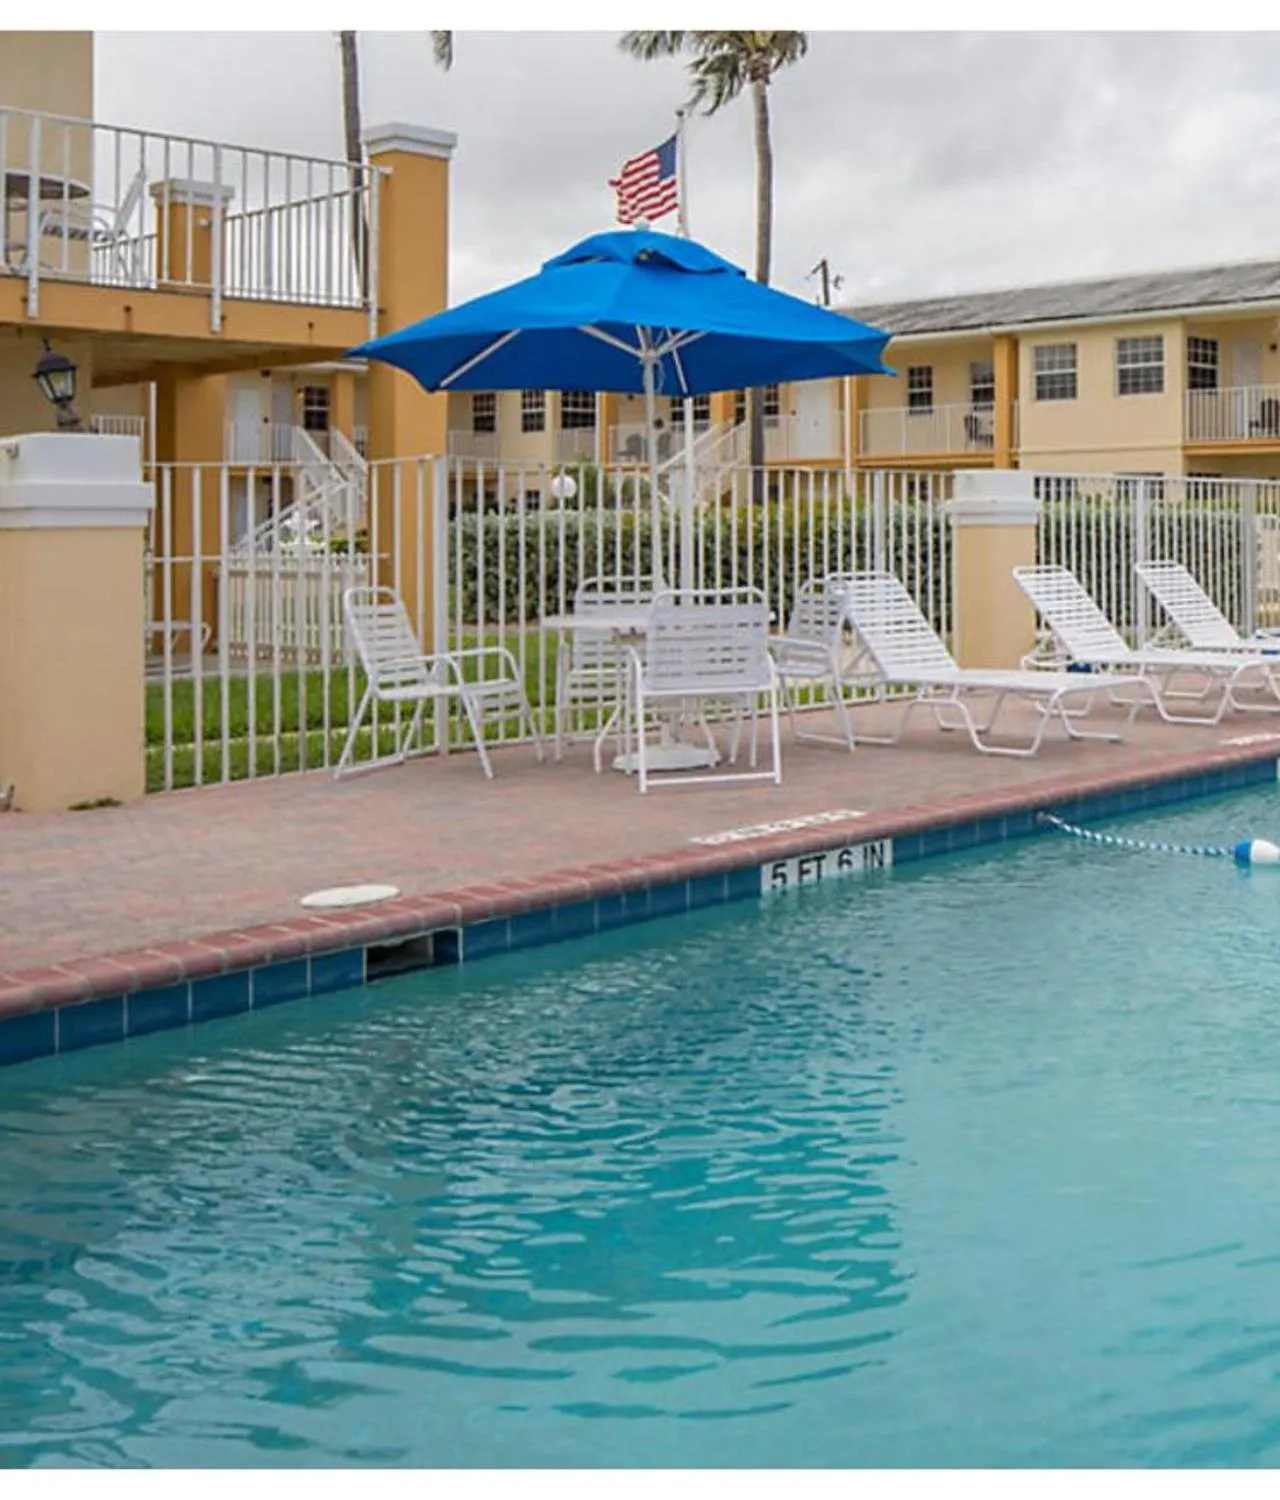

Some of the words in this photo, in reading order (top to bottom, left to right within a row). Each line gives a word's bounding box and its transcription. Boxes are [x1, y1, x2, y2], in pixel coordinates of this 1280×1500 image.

[771, 862, 788, 890] 5
[798, 854, 827, 885] FT
[837, 848, 853, 869] 6
[863, 842, 884, 868] IN
